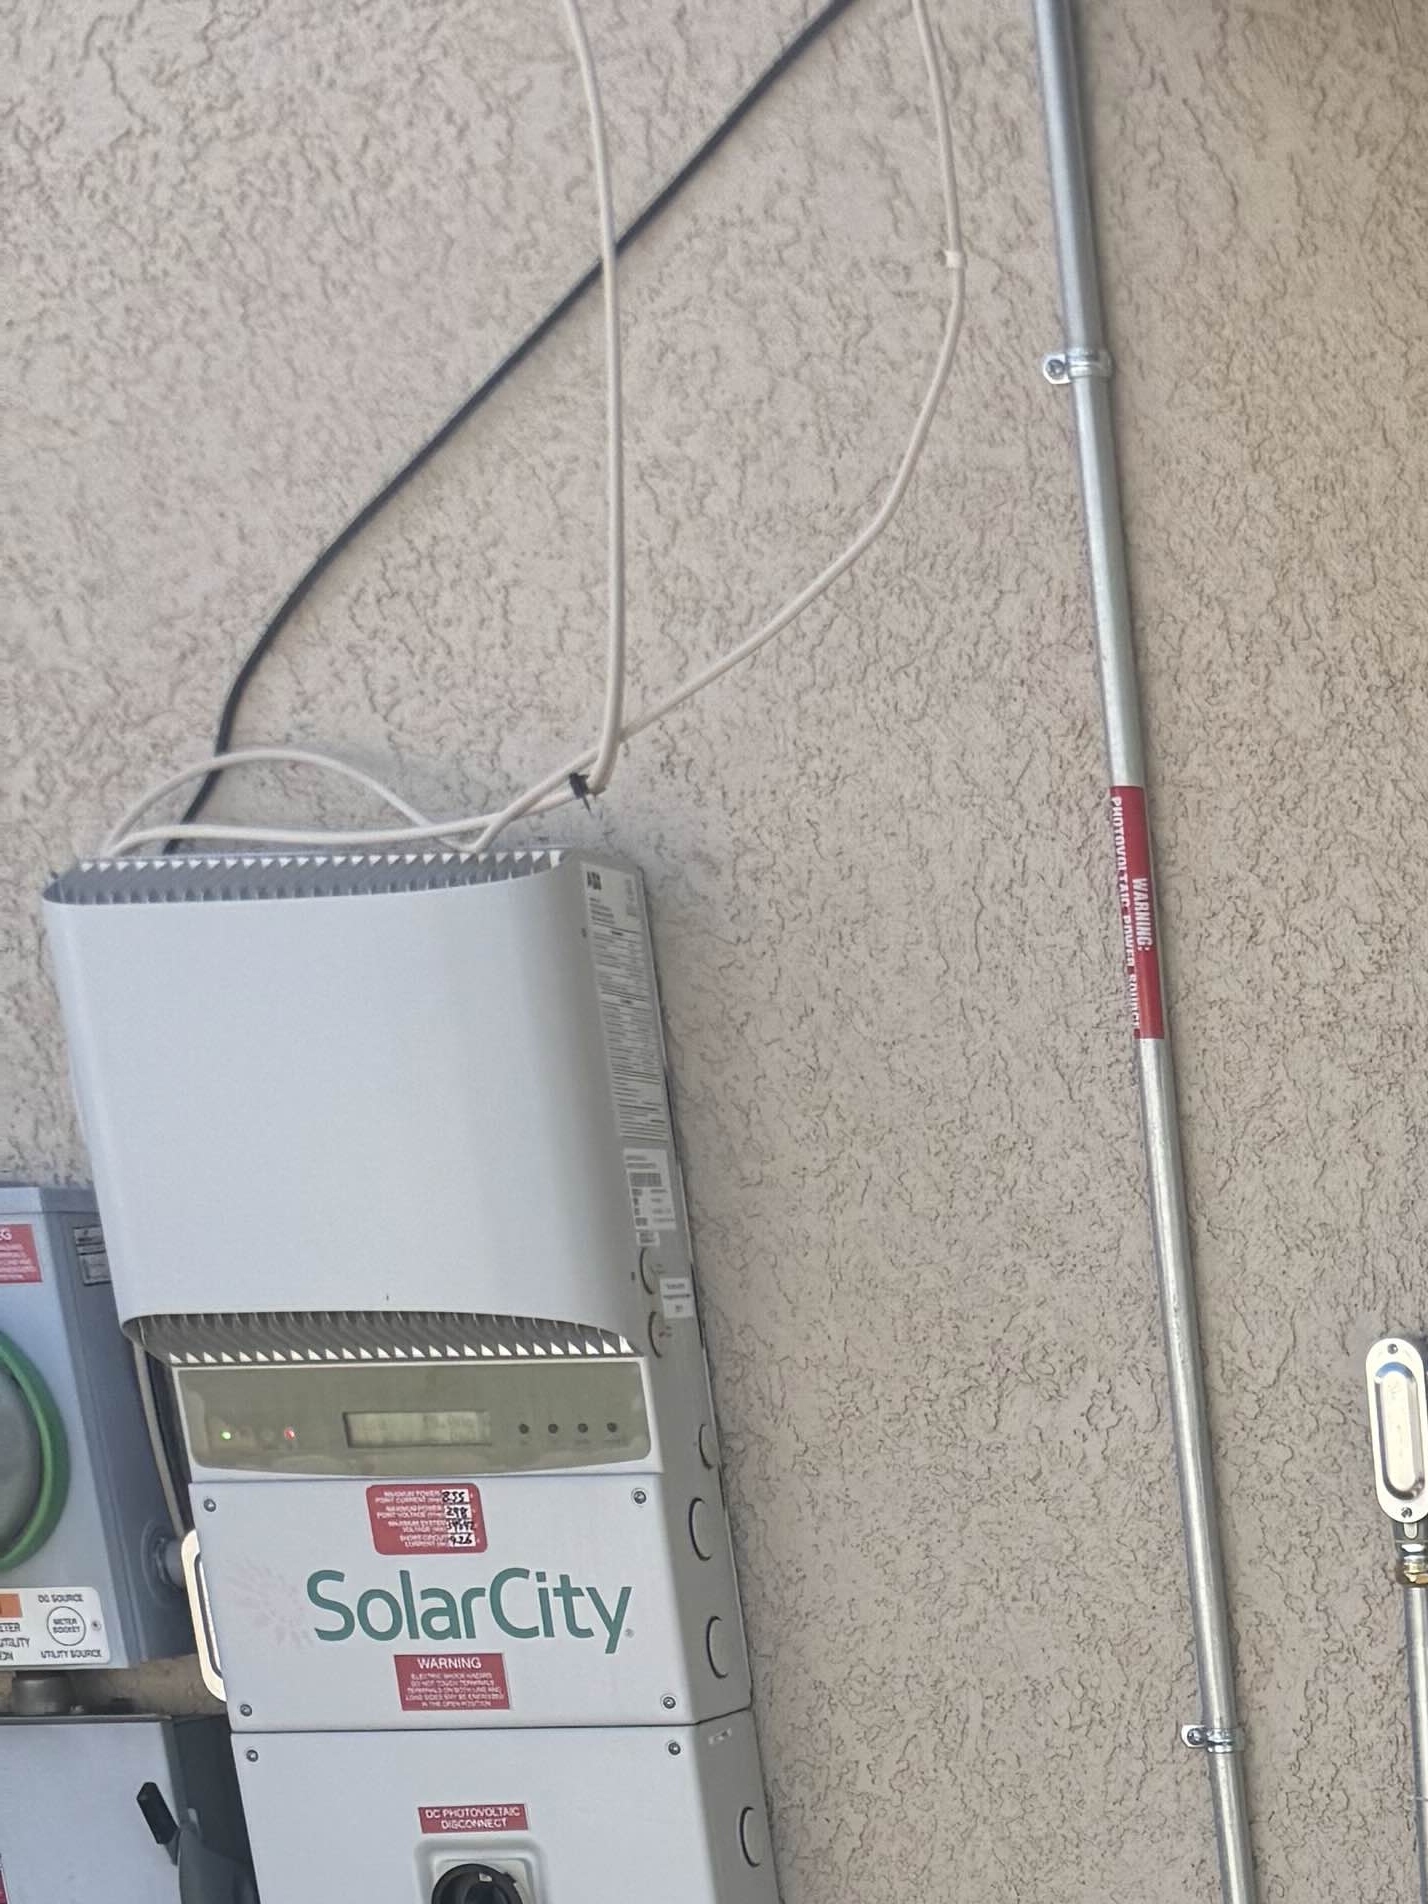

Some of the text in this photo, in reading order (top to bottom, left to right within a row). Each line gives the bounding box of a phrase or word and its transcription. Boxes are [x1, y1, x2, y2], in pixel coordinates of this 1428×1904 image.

[1132, 878, 1152, 952] WARNING:
[307, 1567, 632, 1654] SolarCity
[417, 1657, 482, 1669] WARNING
[425, 1806, 521, 1819] DC PHOTOVOLTAIC
[440, 1818, 507, 1830] DISCONNECT
